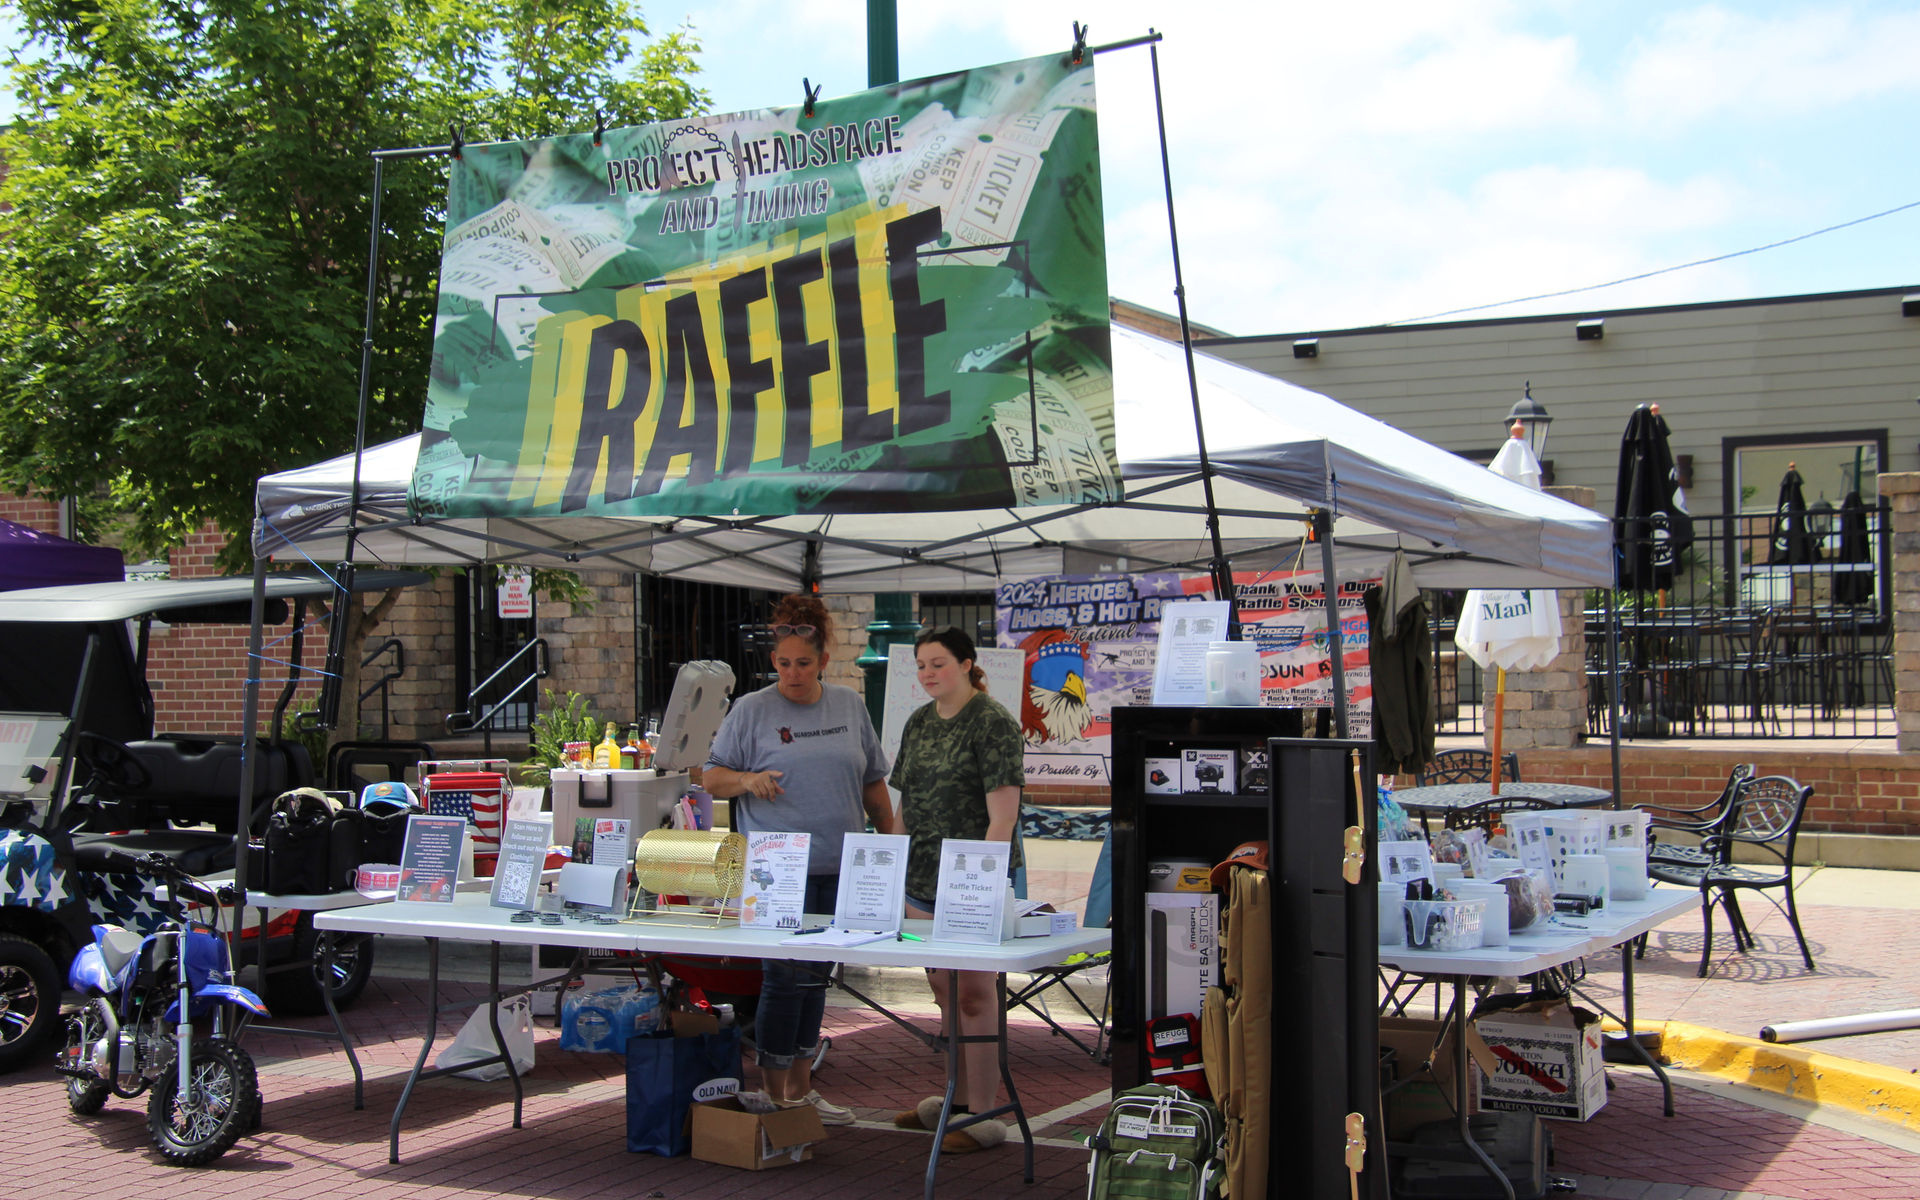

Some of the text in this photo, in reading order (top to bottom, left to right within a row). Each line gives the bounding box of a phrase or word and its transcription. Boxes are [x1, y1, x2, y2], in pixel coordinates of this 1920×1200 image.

[742, 115, 903, 177] HEADSPACE
[907, 135, 947, 194] COUPON
[939, 147, 966, 192] KEEP
[974, 153, 1022, 225] TICKET
[658, 196, 719, 236] AND
[732, 178, 829, 227] TIMING
[560, 205, 952, 515] RAFFLE
[999, 579, 1134, 606] 2024 HEROES,
[1233, 582, 1278, 597] Thank
[1284, 581, 1314, 595] You
[1343, 581, 1377, 593] Our
[1076, 603, 1095, 624] &
[1099, 600, 1141, 622] HOT
[1237, 597, 1366, 611] Raffle Sponors
[1064, 621, 1137, 644] Festival
[1038, 763, 1080, 776] Possible
[769, 833, 788, 841] CART
[949, 882, 993, 892] Raffle Ticket
[960, 894, 979, 902] Table
[1199, 900, 1209, 944] STOCK
[1199, 947, 1209, 966] SA
[1154, 1028, 1188, 1041] REFUGE
[699, 1086, 715, 1098] OLD
[1492, 1100, 1567, 1116] BARTON VODKA
